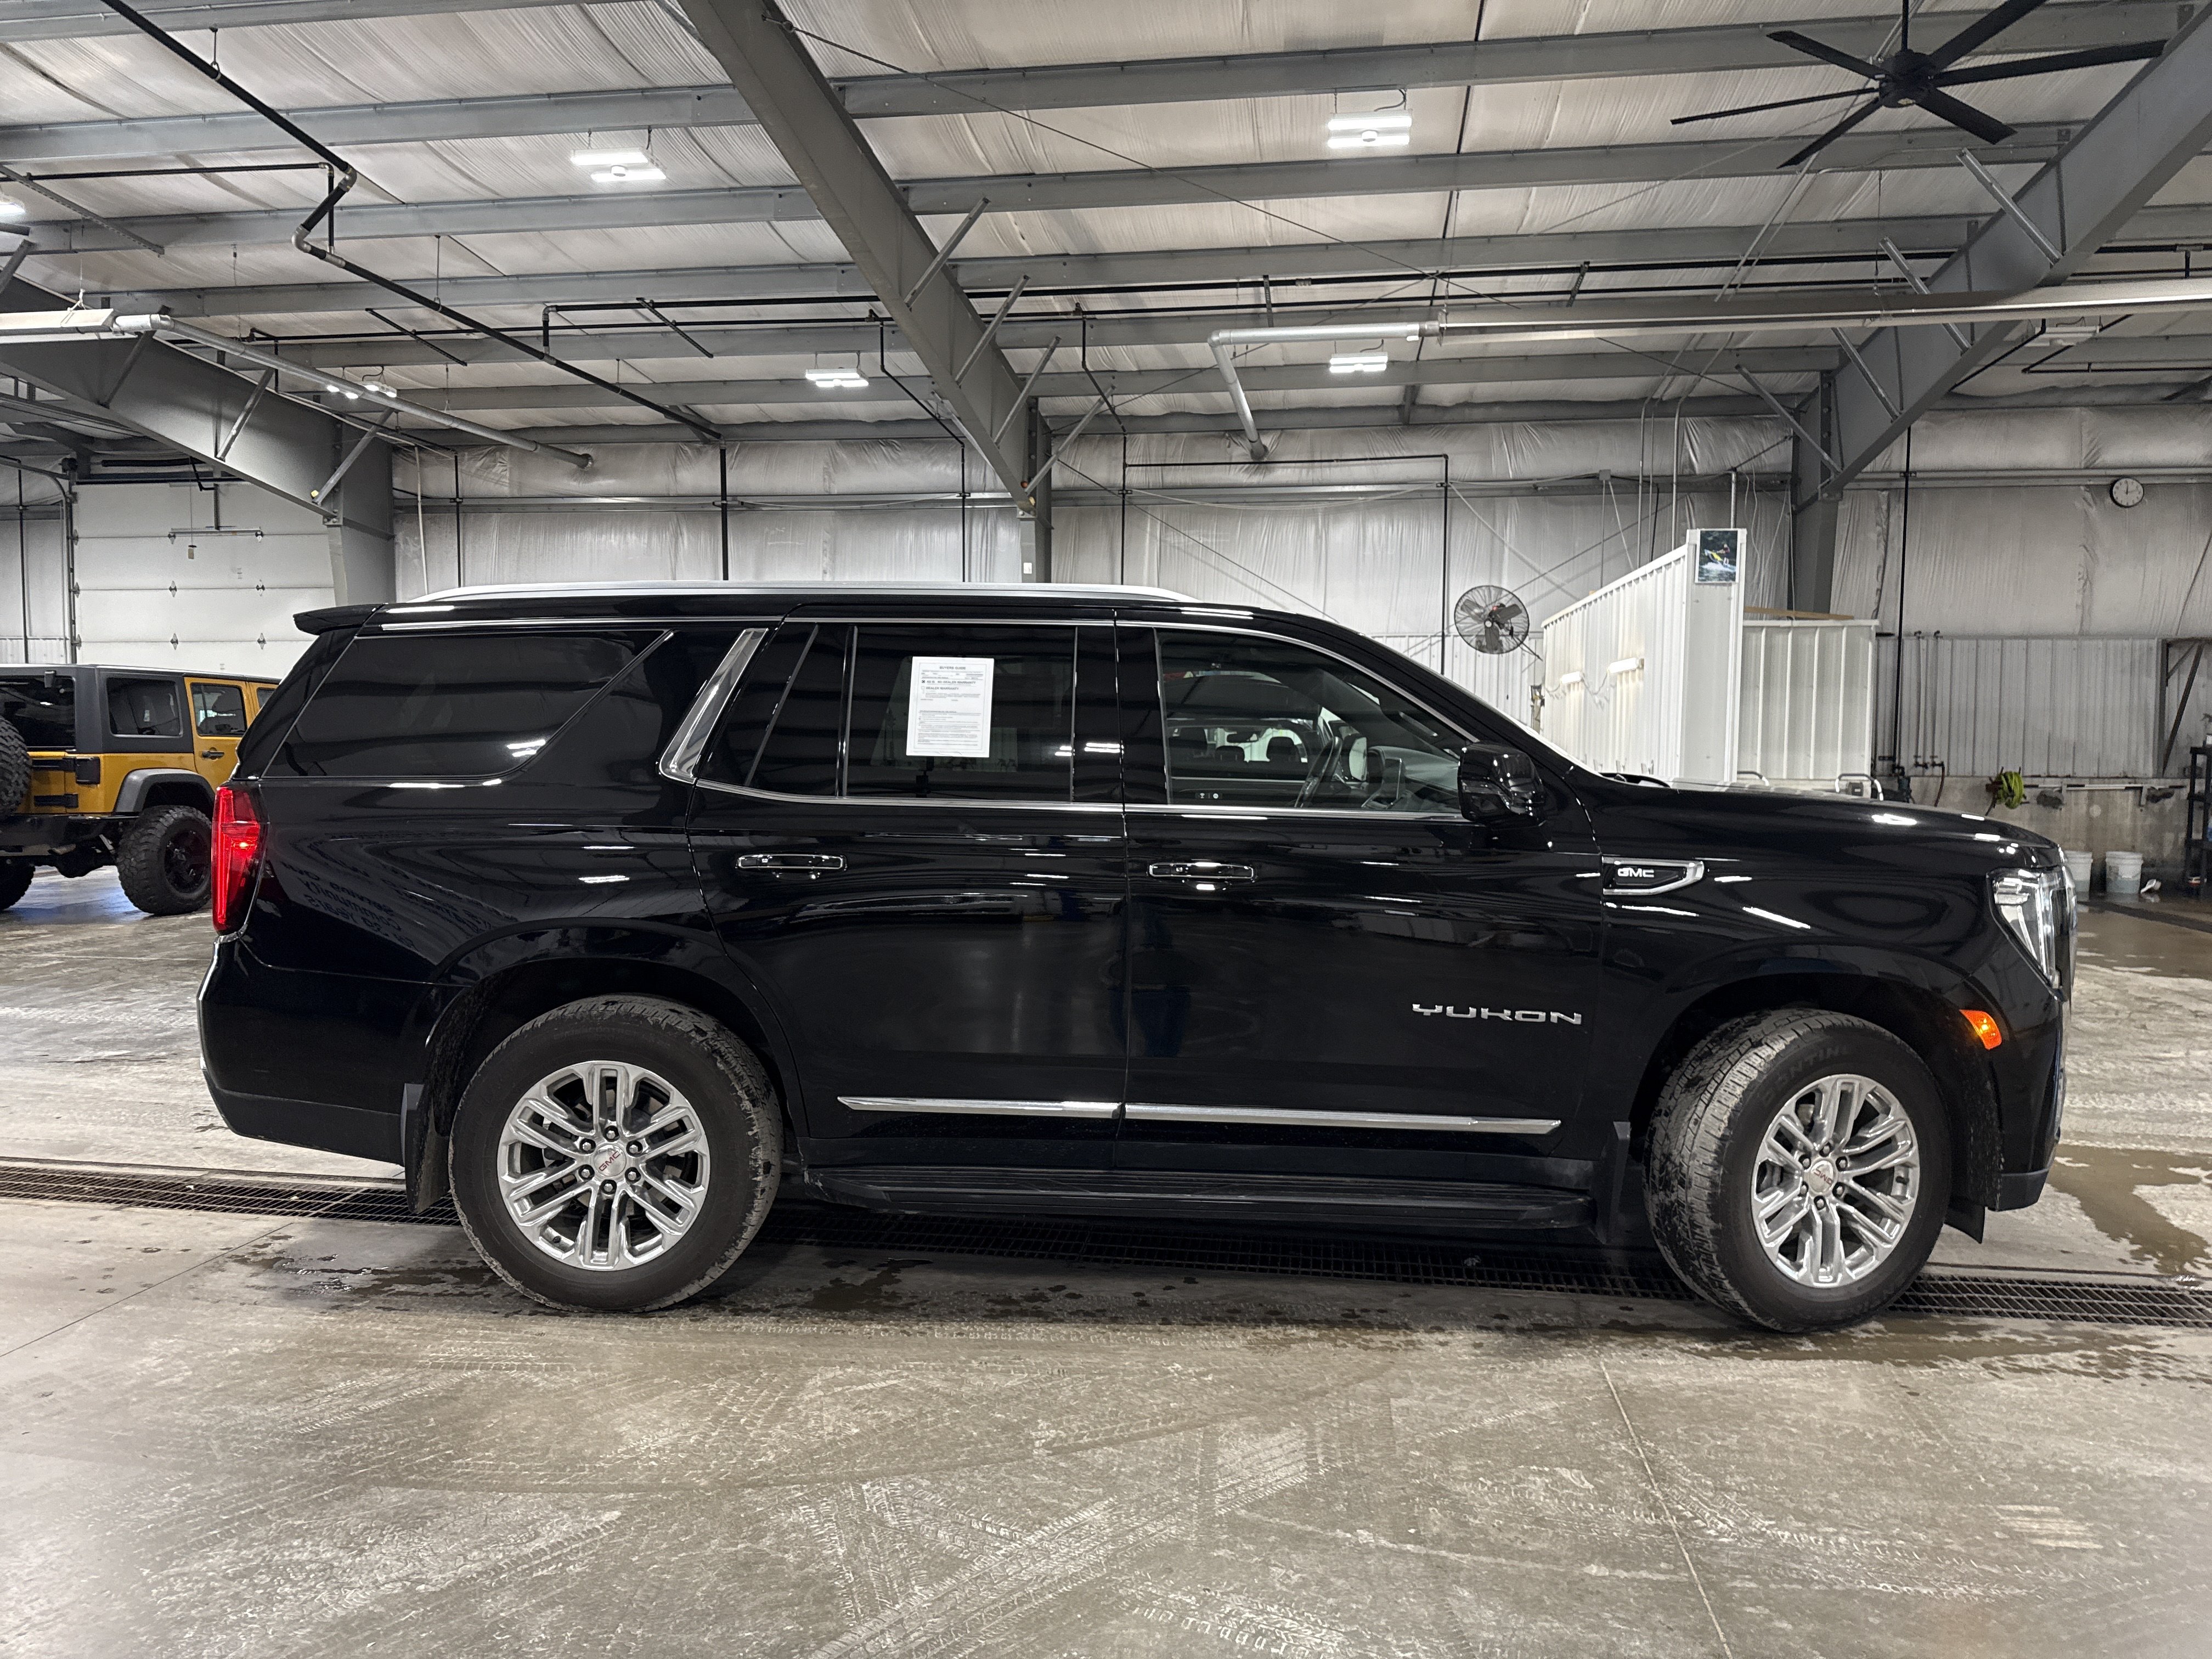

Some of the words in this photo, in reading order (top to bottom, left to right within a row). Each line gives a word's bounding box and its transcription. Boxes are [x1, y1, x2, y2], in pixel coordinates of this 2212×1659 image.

[1617, 867, 1655, 878] GMC
[1412, 1003, 1582, 1025] YUKON
[599, 1150, 621, 1172] GMC
[1814, 1168, 1833, 1185] GMC
